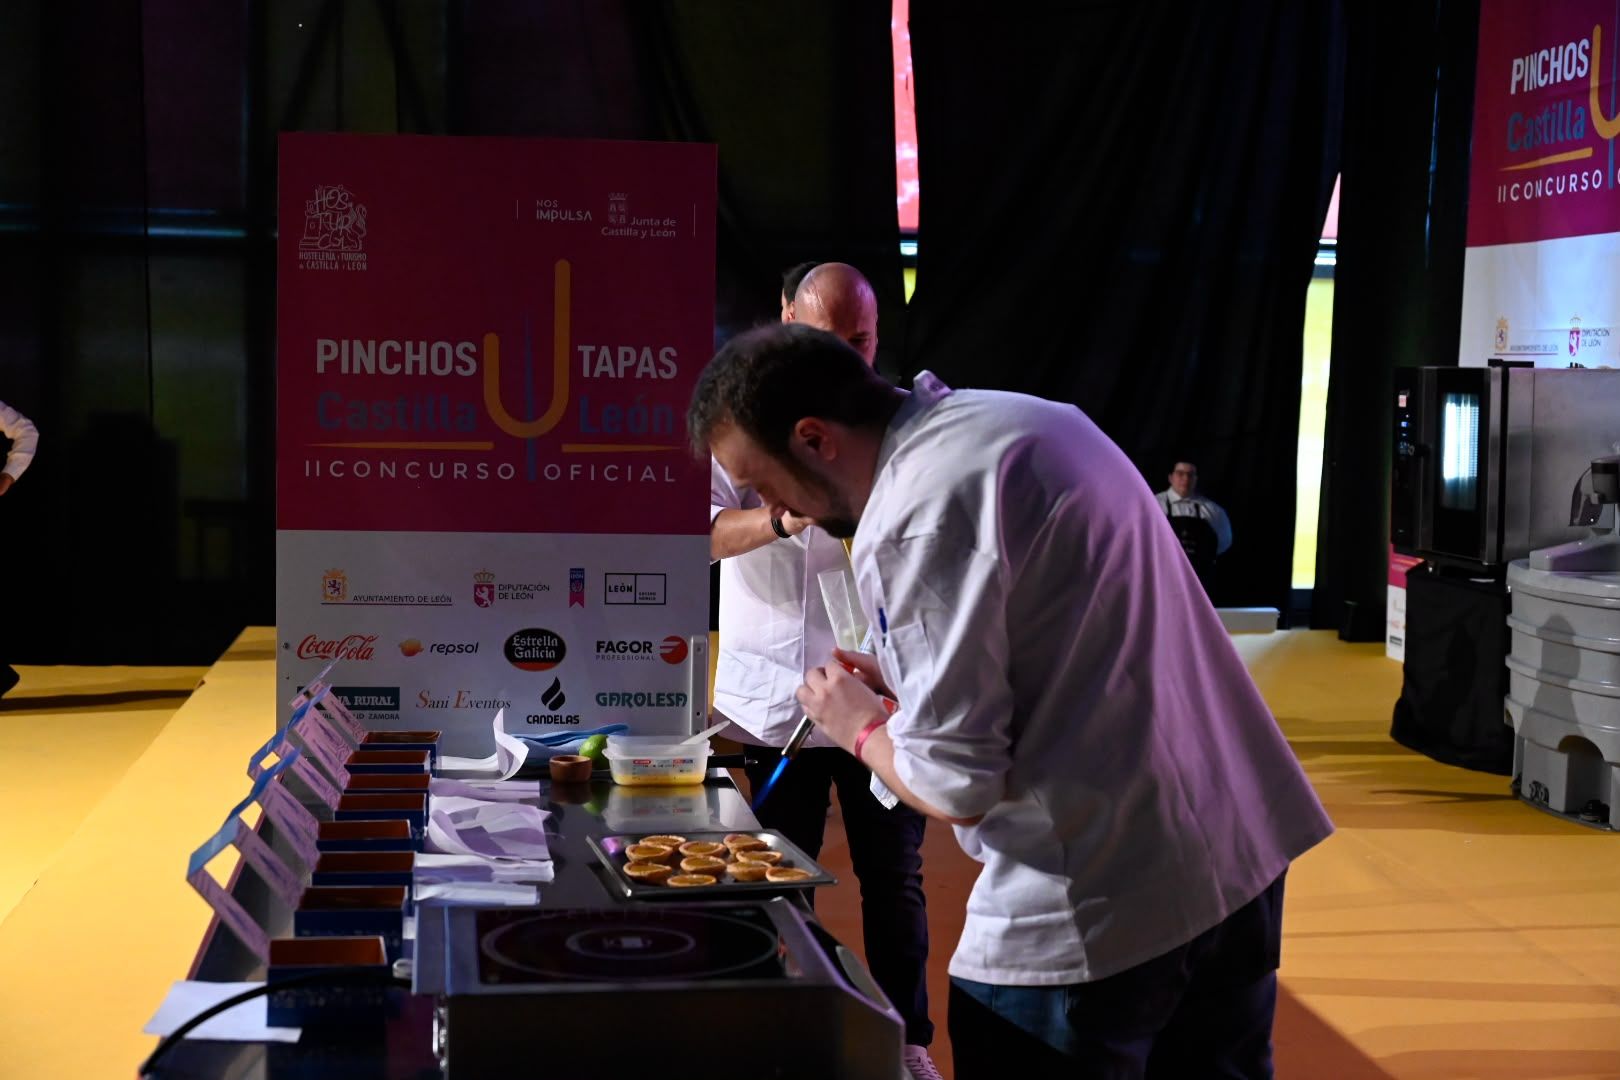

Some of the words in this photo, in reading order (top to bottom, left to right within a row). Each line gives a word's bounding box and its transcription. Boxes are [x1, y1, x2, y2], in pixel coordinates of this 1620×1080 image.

[1510, 38, 1590, 95] PINCHOS
[1507, 99, 1585, 152] Castilla
[536, 199, 559, 208] NOS
[536, 209, 592, 222] IMPULSA
[630, 216, 661, 227] Junta
[662, 217, 677, 227] de
[601, 226, 638, 237] Castilla
[640, 228, 647, 239] y
[650, 227, 676, 237] León
[316, 338, 477, 376] PINCHOS
[577, 345, 678, 379] TAPAS
[317, 390, 477, 432] Castilla
[578, 393, 674, 433] León
[543, 463, 676, 482] OFICIAL
[498, 583, 550, 592] DIPUTACIÓN
[608, 582, 633, 593] LEÓN
[353, 594, 415, 603] AYUNTAMIENTO
[417, 595, 428, 603] DE
[430, 593, 452, 603] LEÓN
[498, 592, 509, 600] DE
[511, 591, 534, 600] LEÓN
[512, 635, 558, 647] Estrella
[596, 640, 653, 654] FAGOR
[430, 642, 479, 656] repsol
[514, 647, 556, 660] Galicia
[353, 695, 395, 706] RURAL
[415, 689, 449, 709] Sani
[452, 690, 512, 709] Eventos
[595, 692, 688, 708] GAROLESA
[368, 713, 400, 721] ZAMORA
[526, 714, 580, 725] CANDELAS
